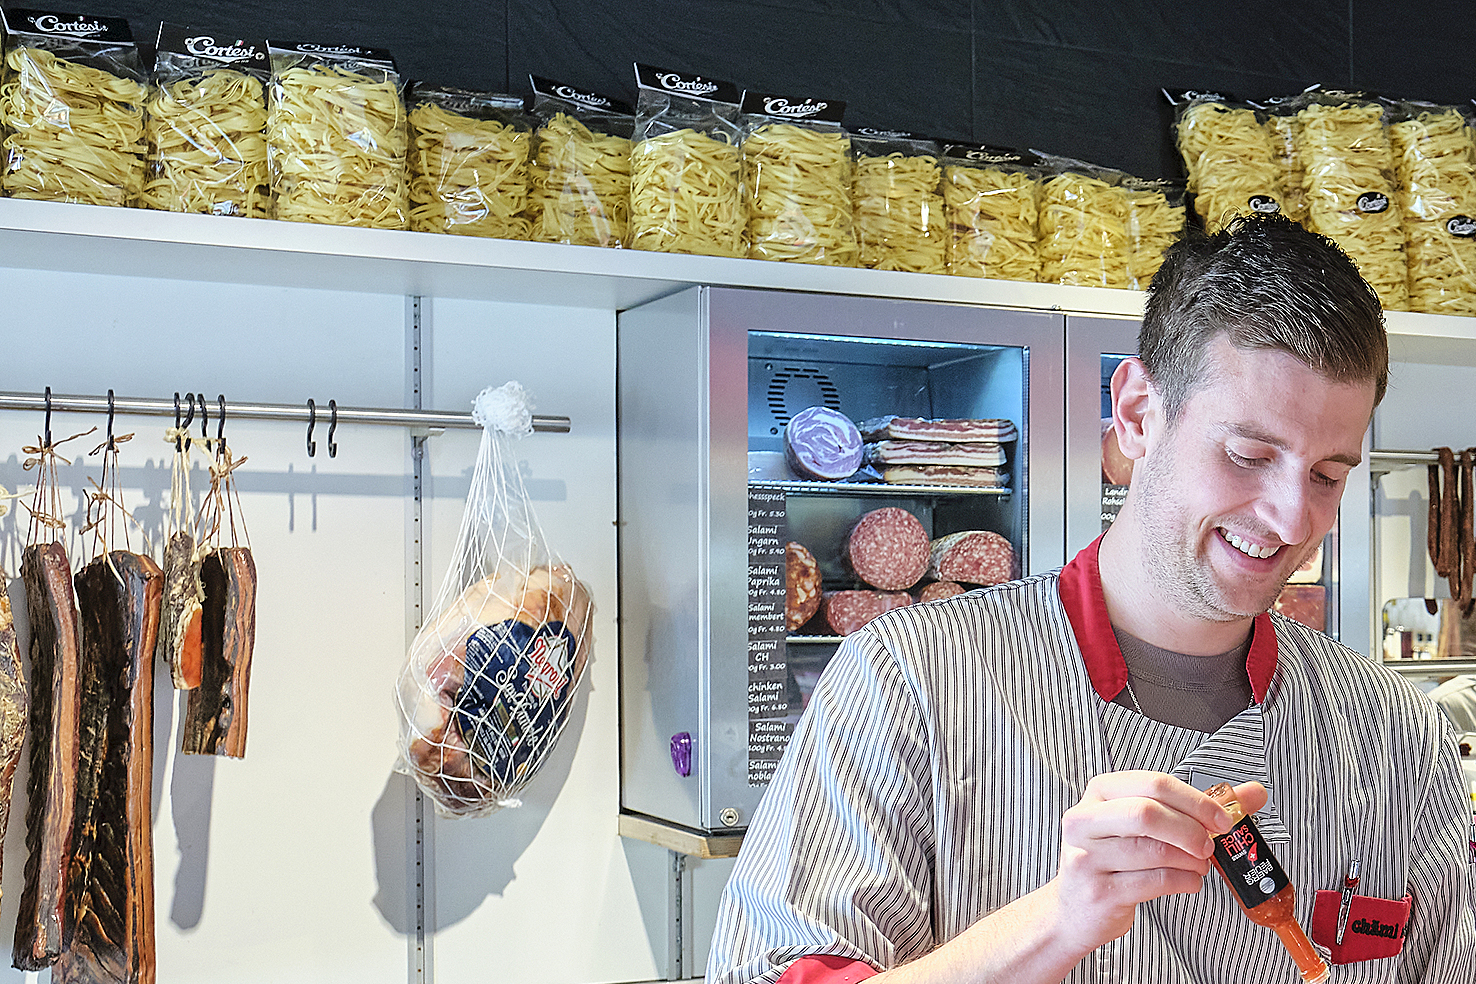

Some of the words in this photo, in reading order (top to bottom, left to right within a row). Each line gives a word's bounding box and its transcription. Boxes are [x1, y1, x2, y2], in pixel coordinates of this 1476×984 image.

[35, 15, 102, 35] Cortesi
[186, 36, 256, 60] Cortesi
[748, 525, 778, 535] Salami
[748, 566, 779, 575] Salami
[748, 603, 775, 612] Salami
[748, 640, 778, 651] Salami
[755, 652, 770, 662] CH
[748, 692, 779, 703] Salami
[755, 722, 786, 732] Salami
[749, 734, 791, 743] Nostrano
[749, 760, 779, 770] Salam
[1220, 824, 1249, 848] SAUCE
[1226, 832, 1255, 857] CHILI
